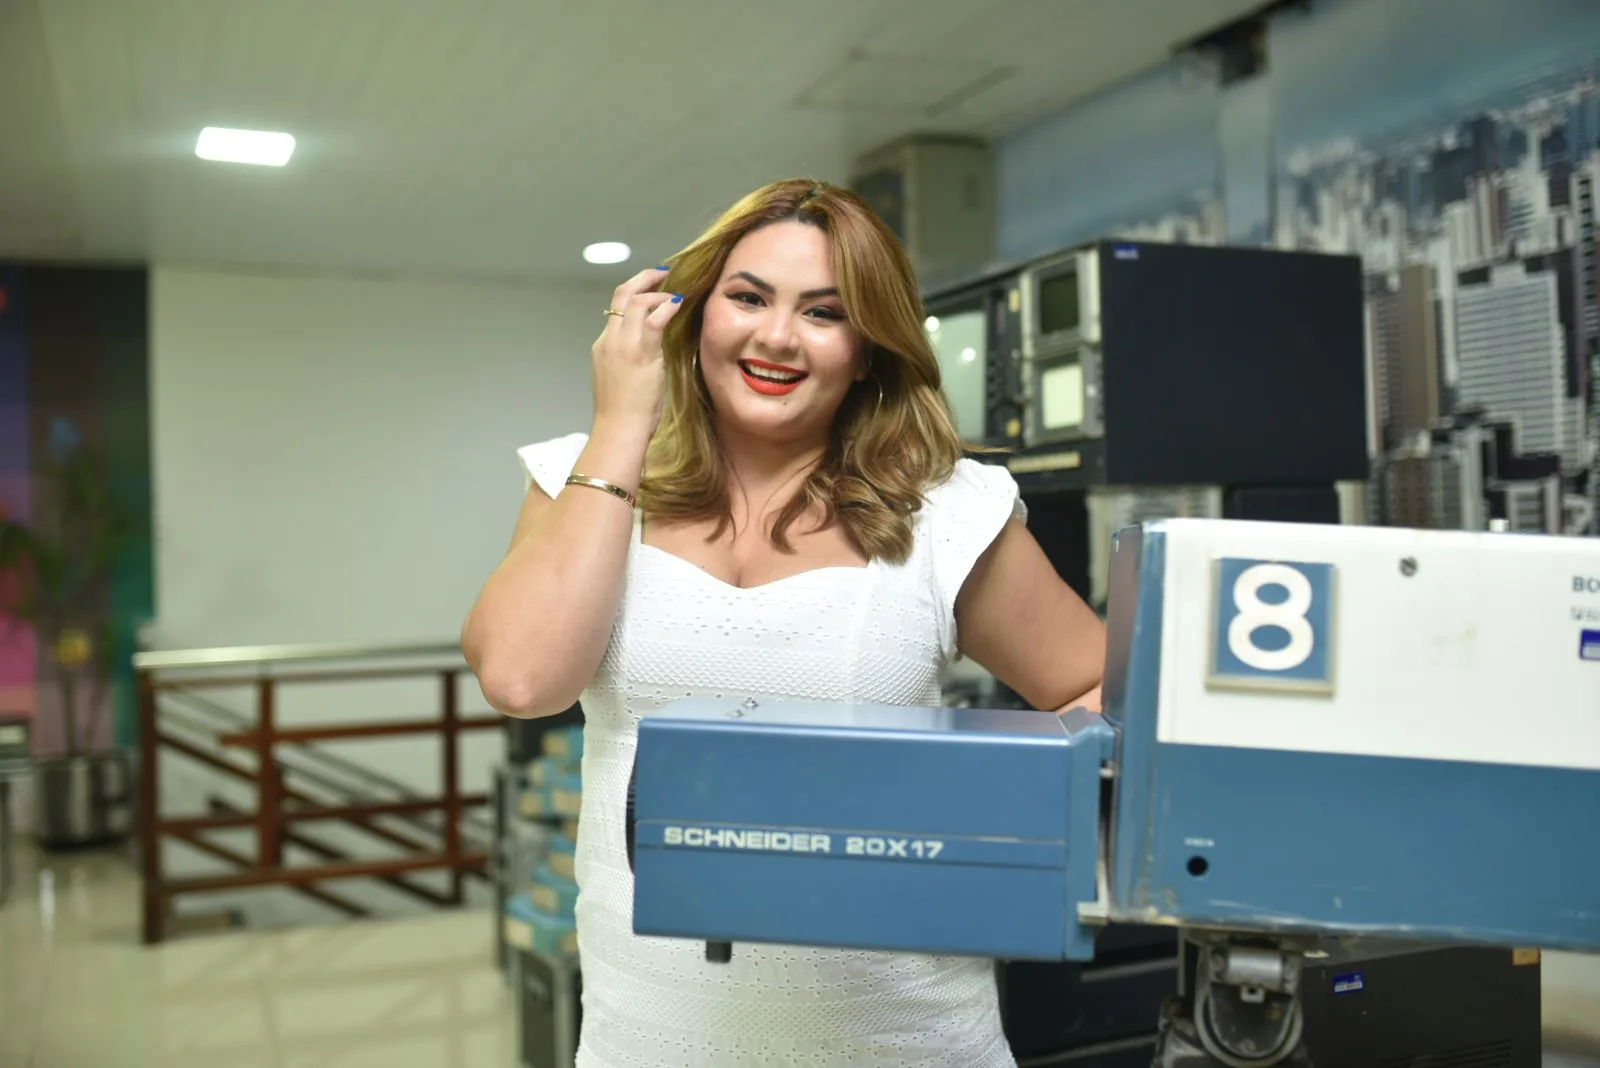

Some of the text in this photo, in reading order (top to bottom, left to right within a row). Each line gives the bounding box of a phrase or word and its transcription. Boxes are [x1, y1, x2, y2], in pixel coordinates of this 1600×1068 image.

[1228, 564, 1314, 671] 8
[664, 826, 943, 859] SCHNEIDER 20X17
